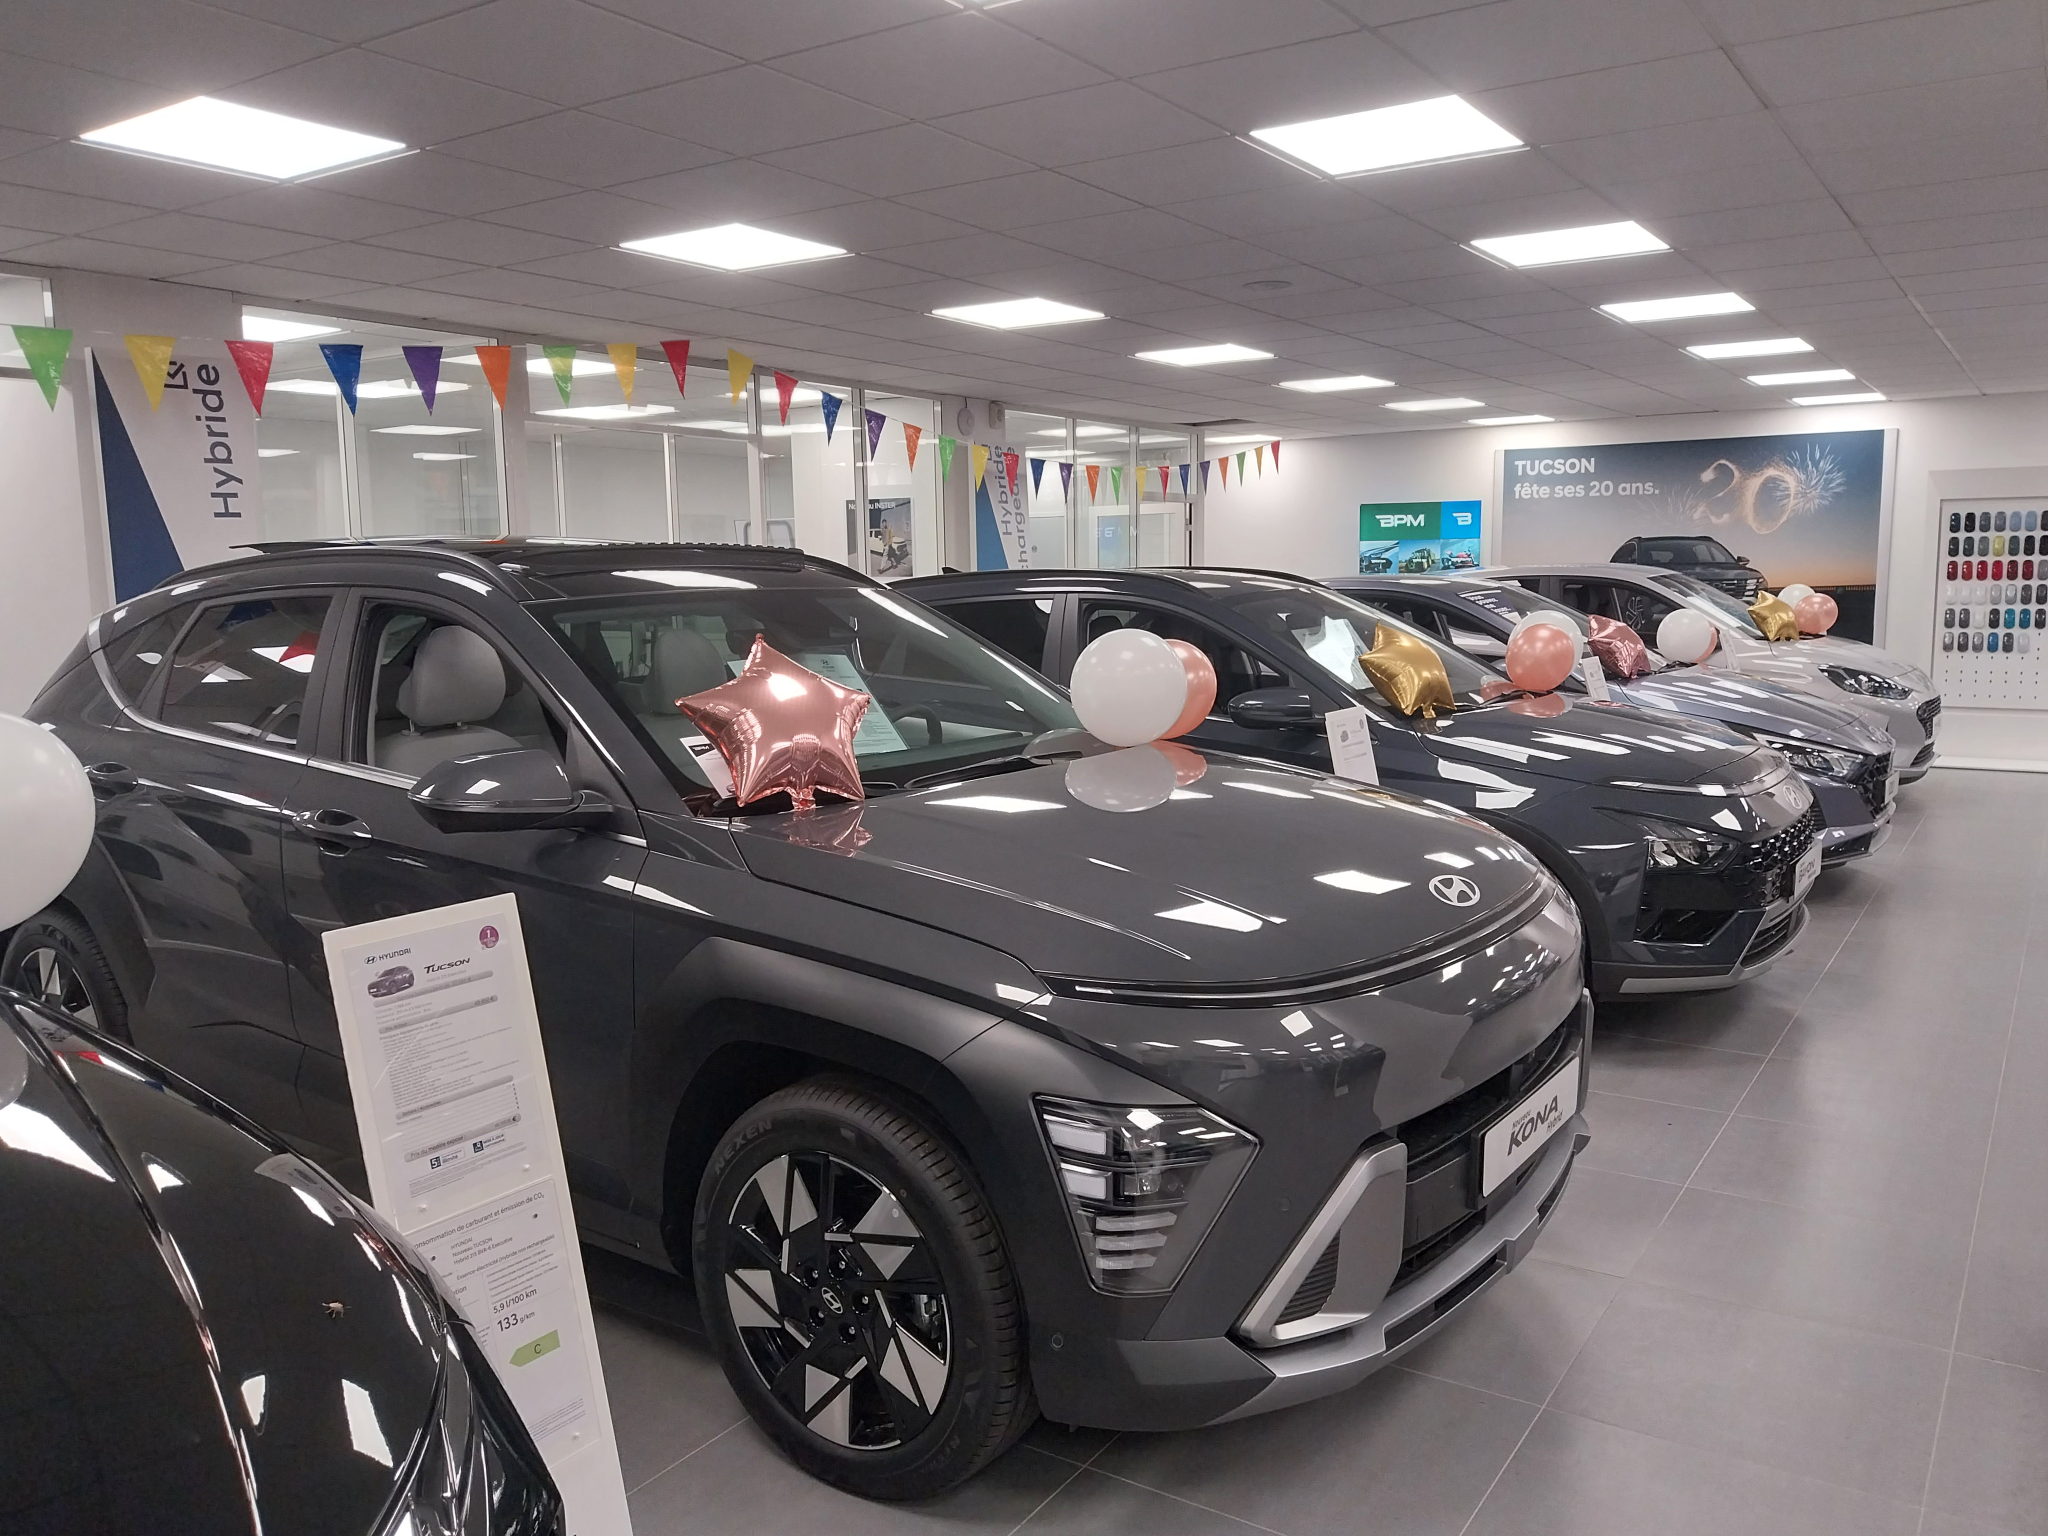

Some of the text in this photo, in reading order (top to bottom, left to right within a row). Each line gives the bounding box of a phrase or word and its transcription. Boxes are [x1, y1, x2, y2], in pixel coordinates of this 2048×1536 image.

[192, 363, 244, 518] Hybride
[1514, 458, 1595, 476] TUCSON
[994, 446, 1012, 536] Hybride
[1514, 480, 1660, 499] fête ses 20 ans.
[1007, 446, 1028, 568] hargeae
[1375, 514, 1424, 528] BPM
[378, 948, 412, 961] HYUNDAI
[1507, 1094, 1558, 1156] KONA
[715, 1120, 772, 1175] NEXEN
[414, 1228, 456, 1250] onsommation
[465, 1212, 493, 1229] carburant
[501, 1200, 525, 1214] émission
[450, 1237, 473, 1250] HYUNDAI
[493, 1302, 505, 1314] 5,9
[525, 1288, 537, 1300] km
[497, 1311, 536, 1332] 133 g/km
[534, 1344, 542, 1354] C
